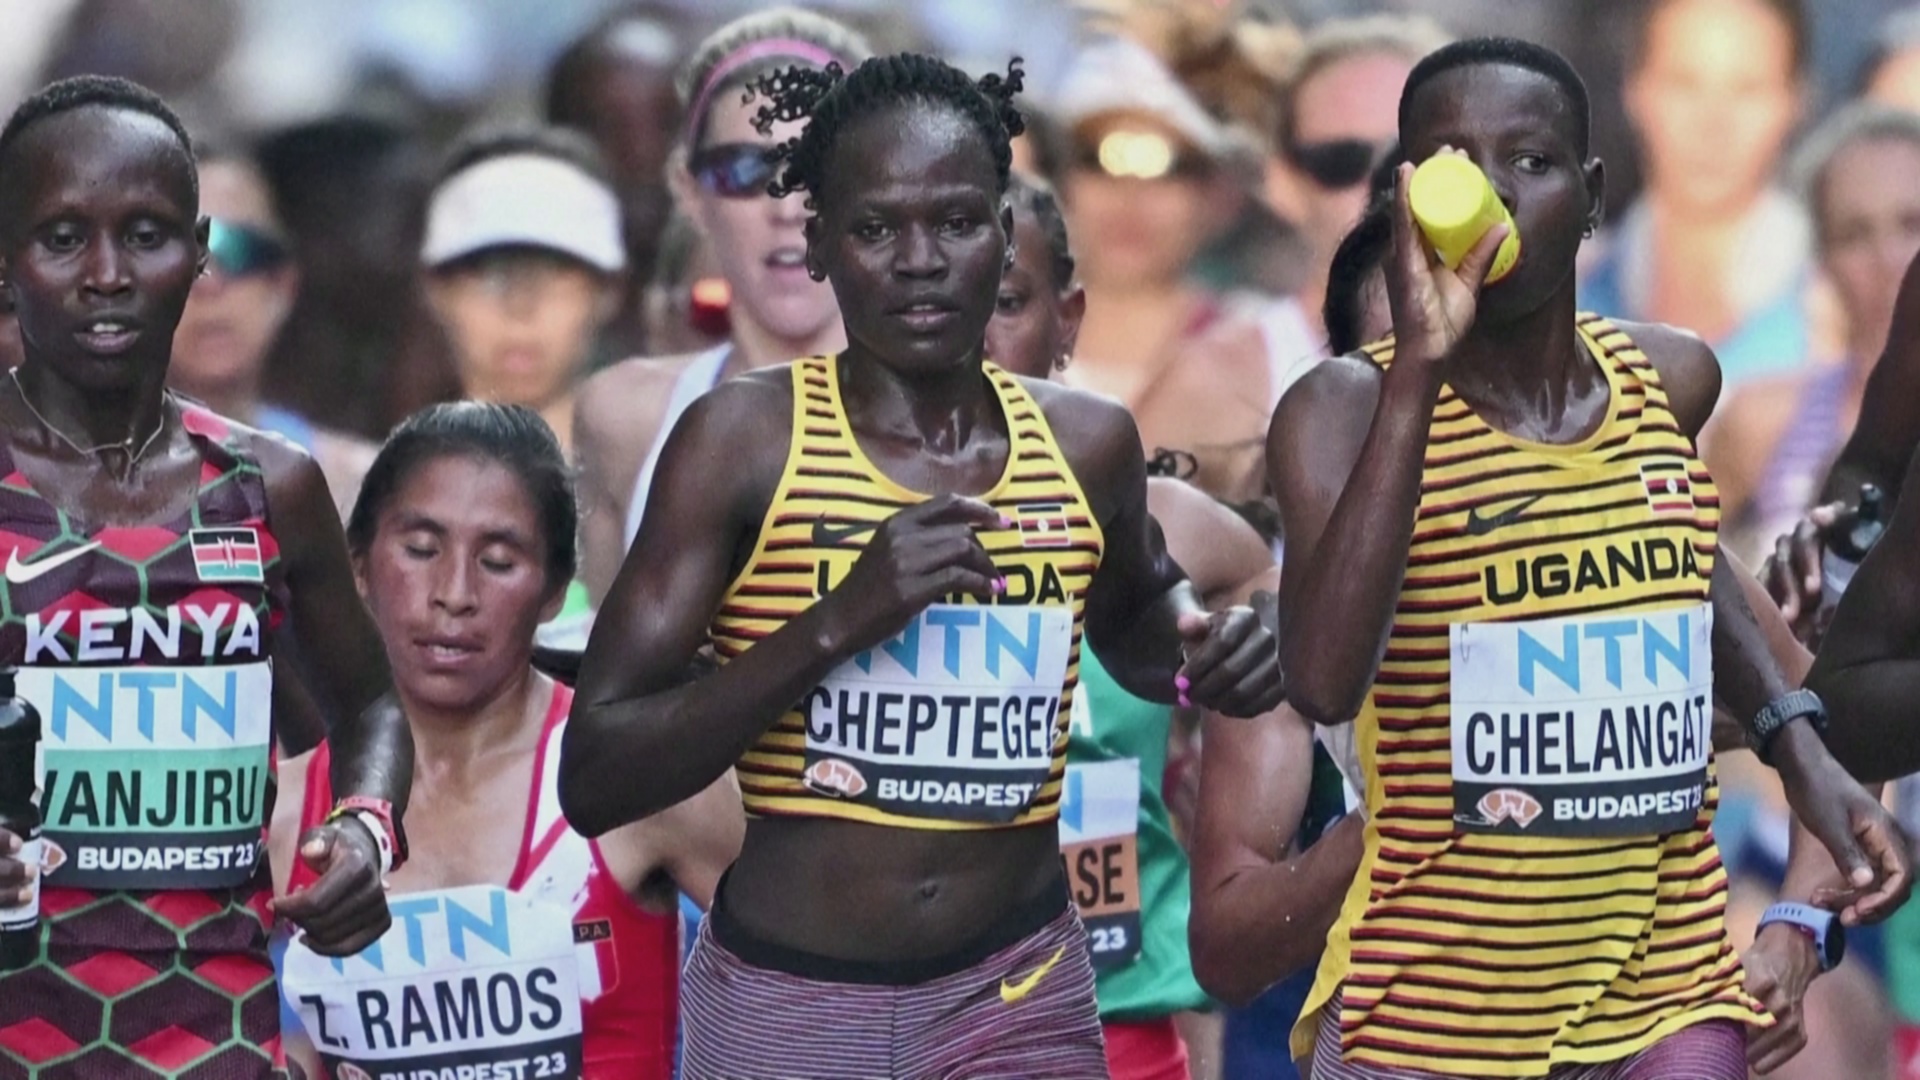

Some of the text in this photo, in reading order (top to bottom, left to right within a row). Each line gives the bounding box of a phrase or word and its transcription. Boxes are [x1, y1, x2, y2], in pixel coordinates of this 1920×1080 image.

[1485, 537, 1700, 606] UGANDA
[25, 602, 260, 663] KENYA
[1517, 613, 1691, 696] NTN
[51, 670, 237, 743] NTN
[1465, 695, 1705, 776] CHELANGAT
[41, 765, 258, 828] ANJIRU
[877, 778, 1034, 807] BUDAPEST
[1553, 787, 1692, 821] BUDAPEST
[77, 843, 254, 870] BUDAPEST 23
[1092, 927, 1127, 952] 23
[299, 966, 562, 1051] Z. RAMOS
[533, 1051, 567, 1078] 23
